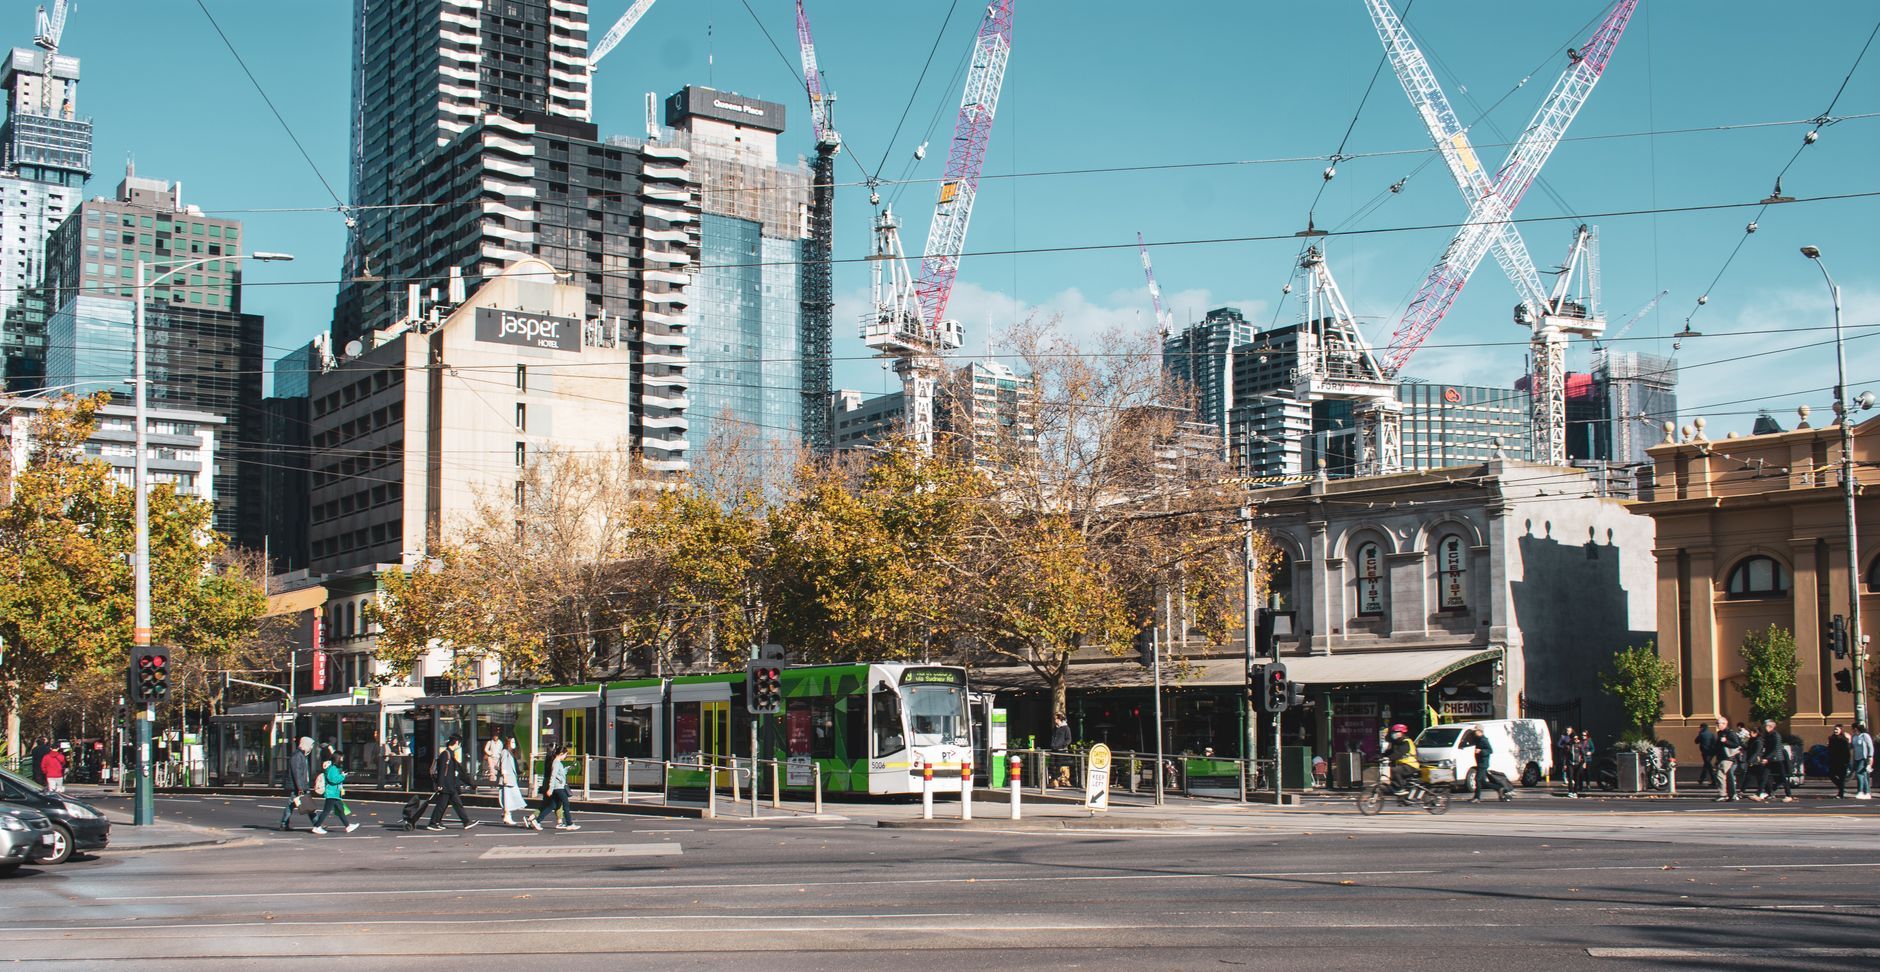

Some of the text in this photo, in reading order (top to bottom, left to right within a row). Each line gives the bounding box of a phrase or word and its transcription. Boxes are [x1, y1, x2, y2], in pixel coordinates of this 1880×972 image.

[713, 99, 764, 116] Queens Place
[537, 339, 560, 348] HOTEL
[1366, 559, 1379, 601] CHEMIST
[1448, 552, 1461, 596] CHEMIST
[1444, 703, 1489, 713] CHEMIST
[872, 761, 886, 769] 5006
